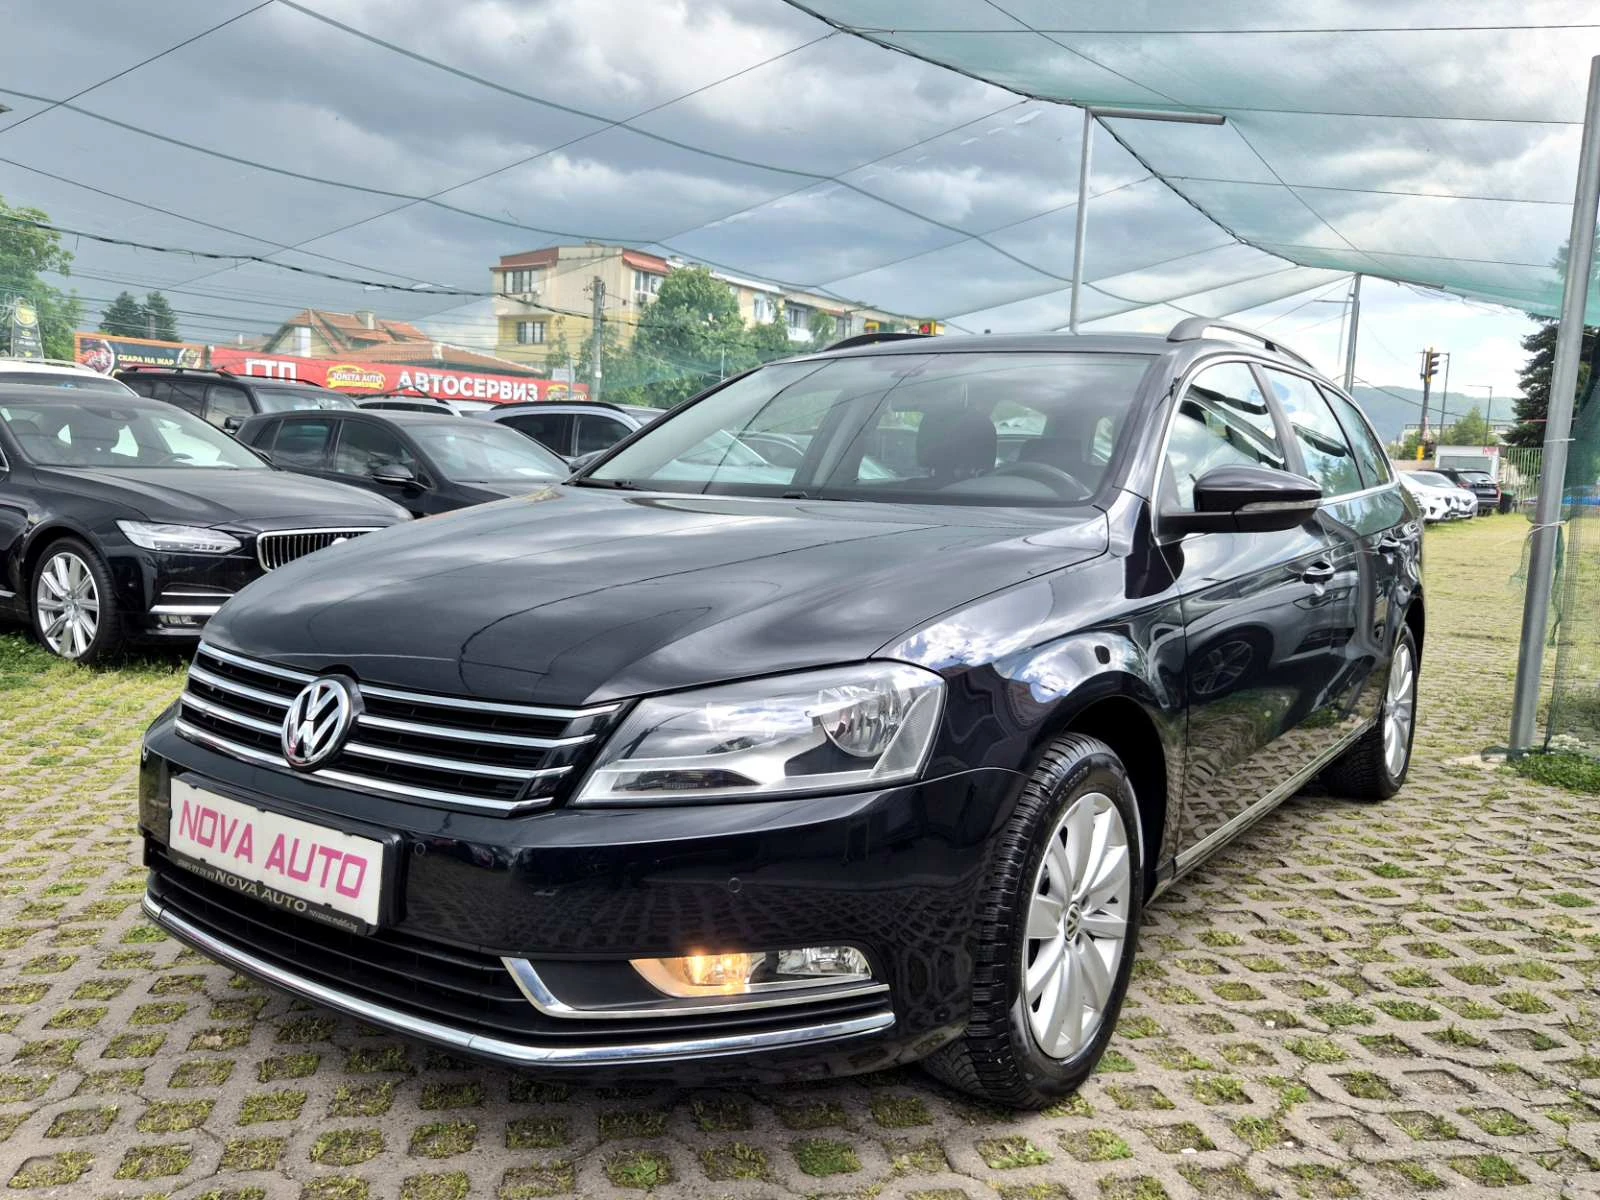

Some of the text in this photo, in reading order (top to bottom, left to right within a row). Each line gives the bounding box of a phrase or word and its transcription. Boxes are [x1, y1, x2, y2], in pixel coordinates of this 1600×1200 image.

[144, 356, 156, 365] НА
[245, 358, 297, 384] ГТП
[399, 371, 538, 401] АВТОСЕРВИЗ
[179, 800, 368, 899] NOVA AUTO
[214, 870, 308, 913] NOVA AUTO
